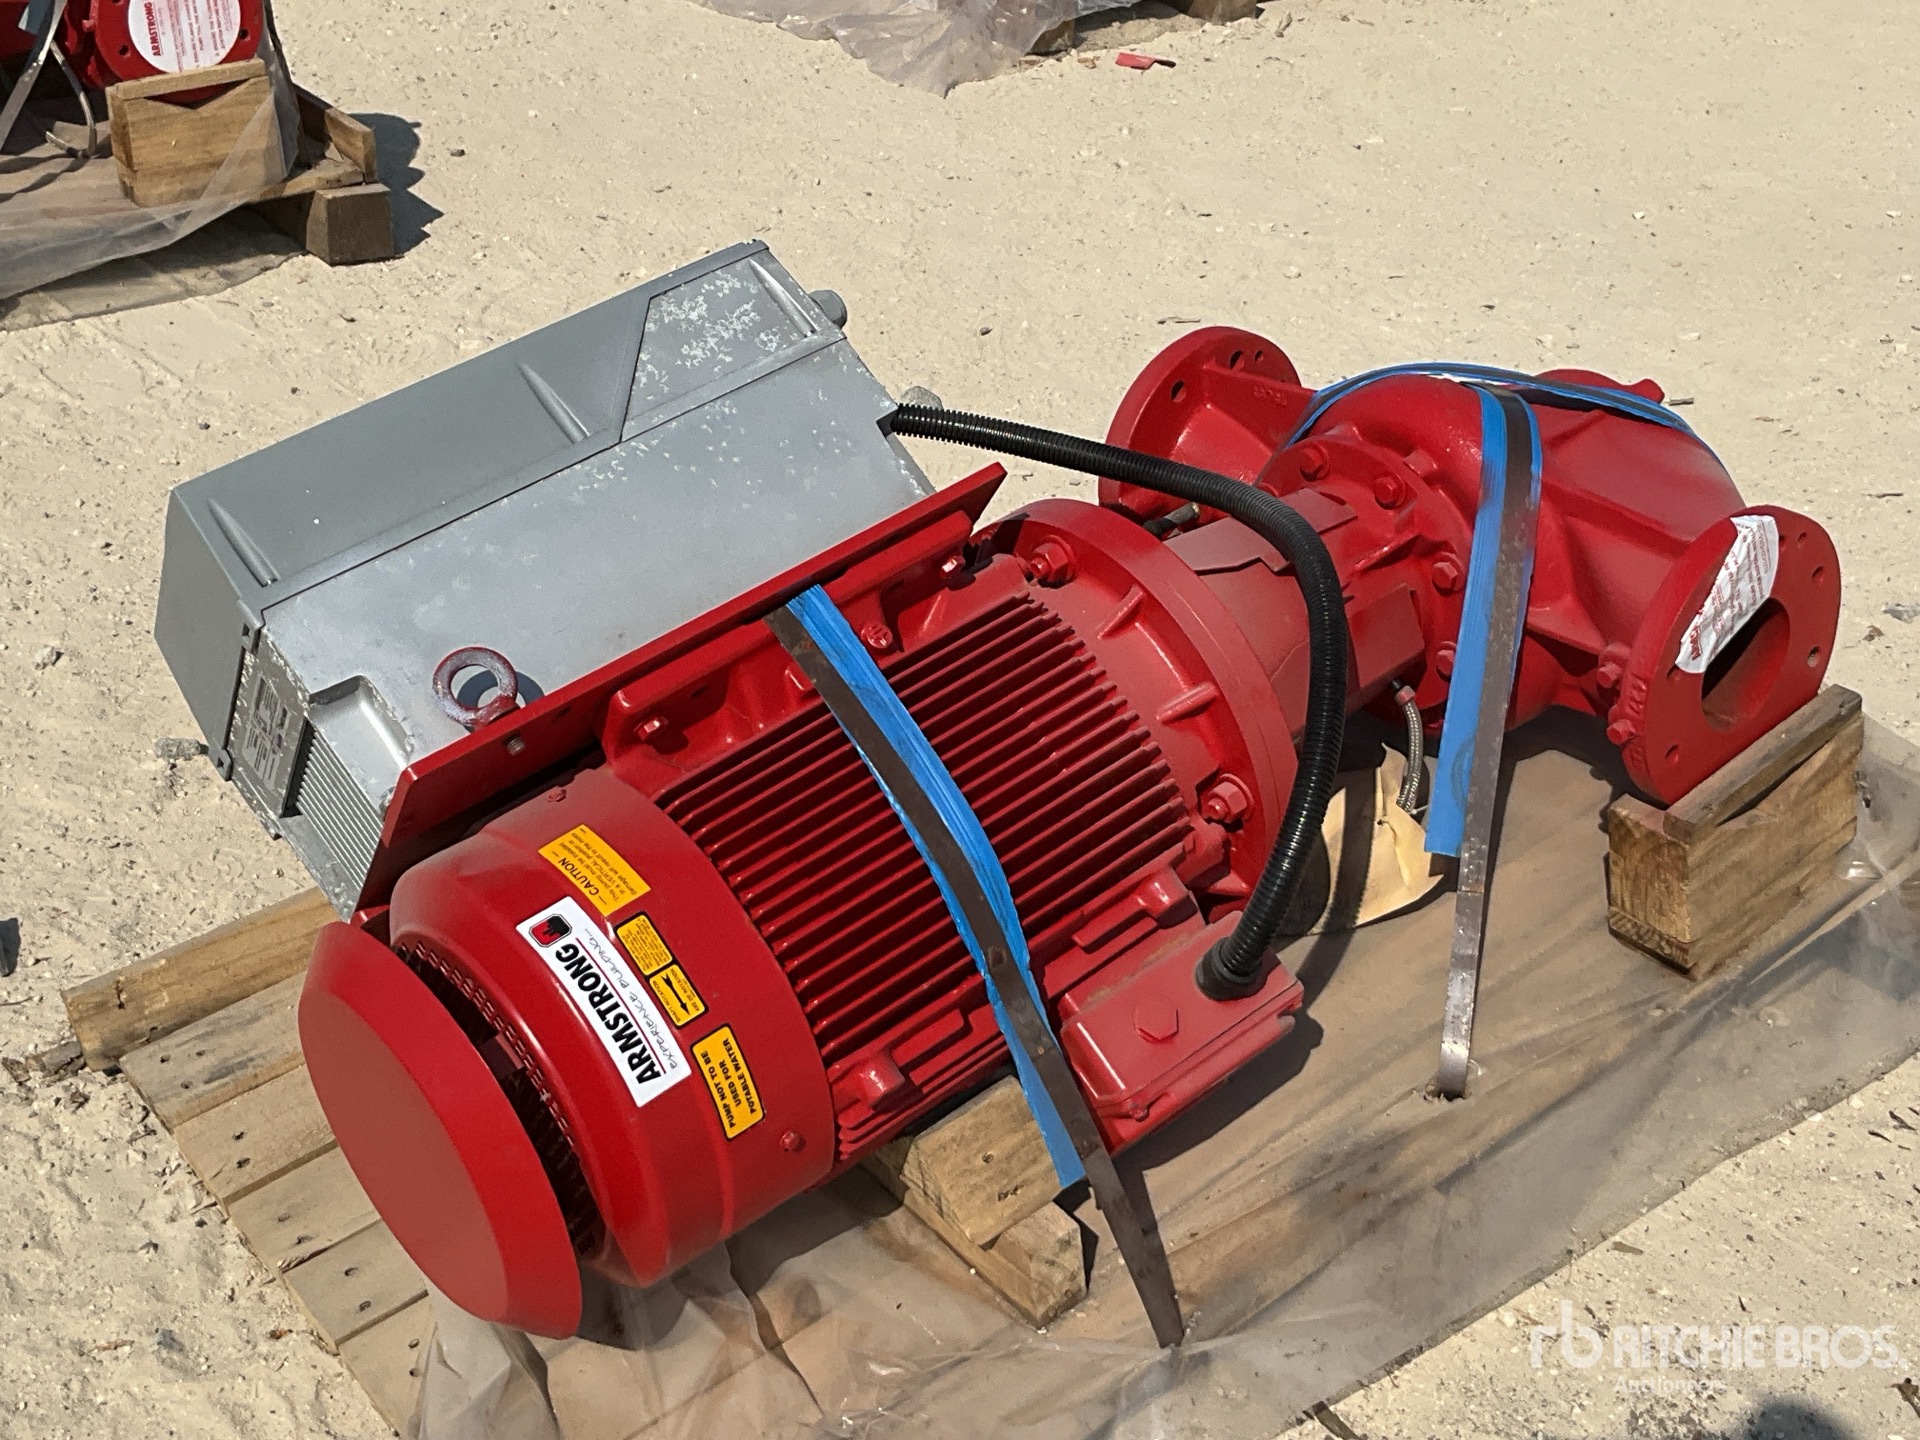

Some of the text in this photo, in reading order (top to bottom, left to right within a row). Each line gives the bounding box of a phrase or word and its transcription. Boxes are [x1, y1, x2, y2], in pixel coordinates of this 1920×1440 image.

[144, 2, 161, 56] ARMSTRONG
[558, 857, 600, 896] CAUTION
[590, 859, 617, 885] VERTICAL
[652, 980, 681, 1023] SHAFT ROTATION
[670, 968, 688, 994] ROTATION
[555, 942, 661, 1084] ARMSTRONG
[627, 989, 678, 1070] EXPERIENCE
[701, 1050, 736, 1128] PUMP NOT TO BE
[718, 1060, 742, 1107] USED FOR
[722, 1038, 757, 1114] POTABLE WATER
